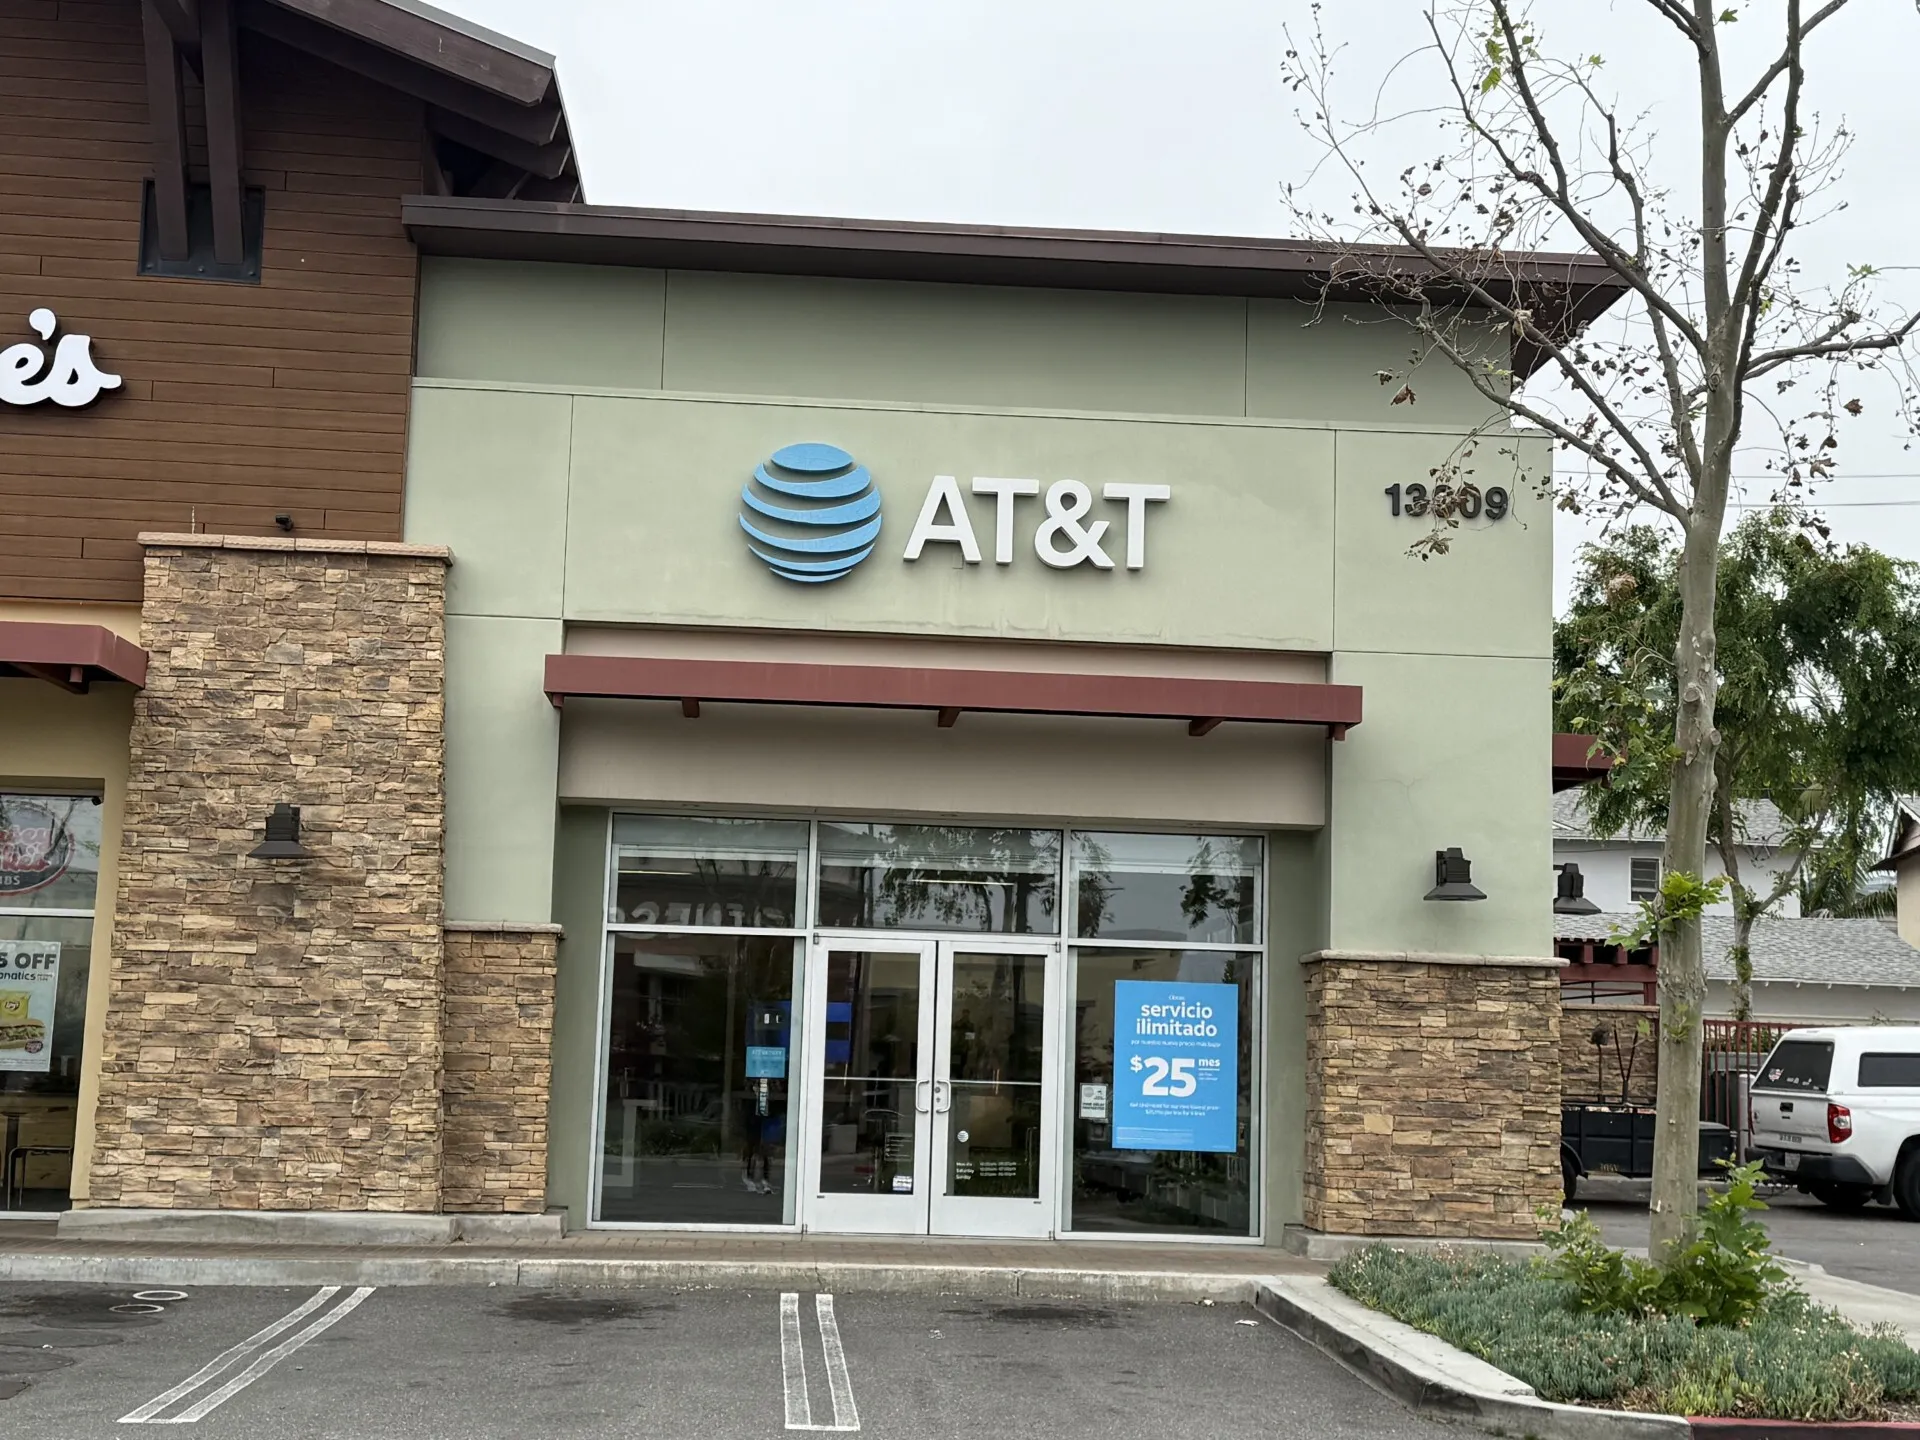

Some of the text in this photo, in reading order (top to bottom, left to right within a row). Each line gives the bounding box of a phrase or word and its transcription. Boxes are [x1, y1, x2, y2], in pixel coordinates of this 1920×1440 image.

[903, 475, 1171, 570] AT&T
[15, 953, 57, 970] OFF
[1141, 1002, 1213, 1019] servicio
[1136, 1018, 1218, 1037] ilimitado
[1130, 1054, 1221, 1098] $25 mes
